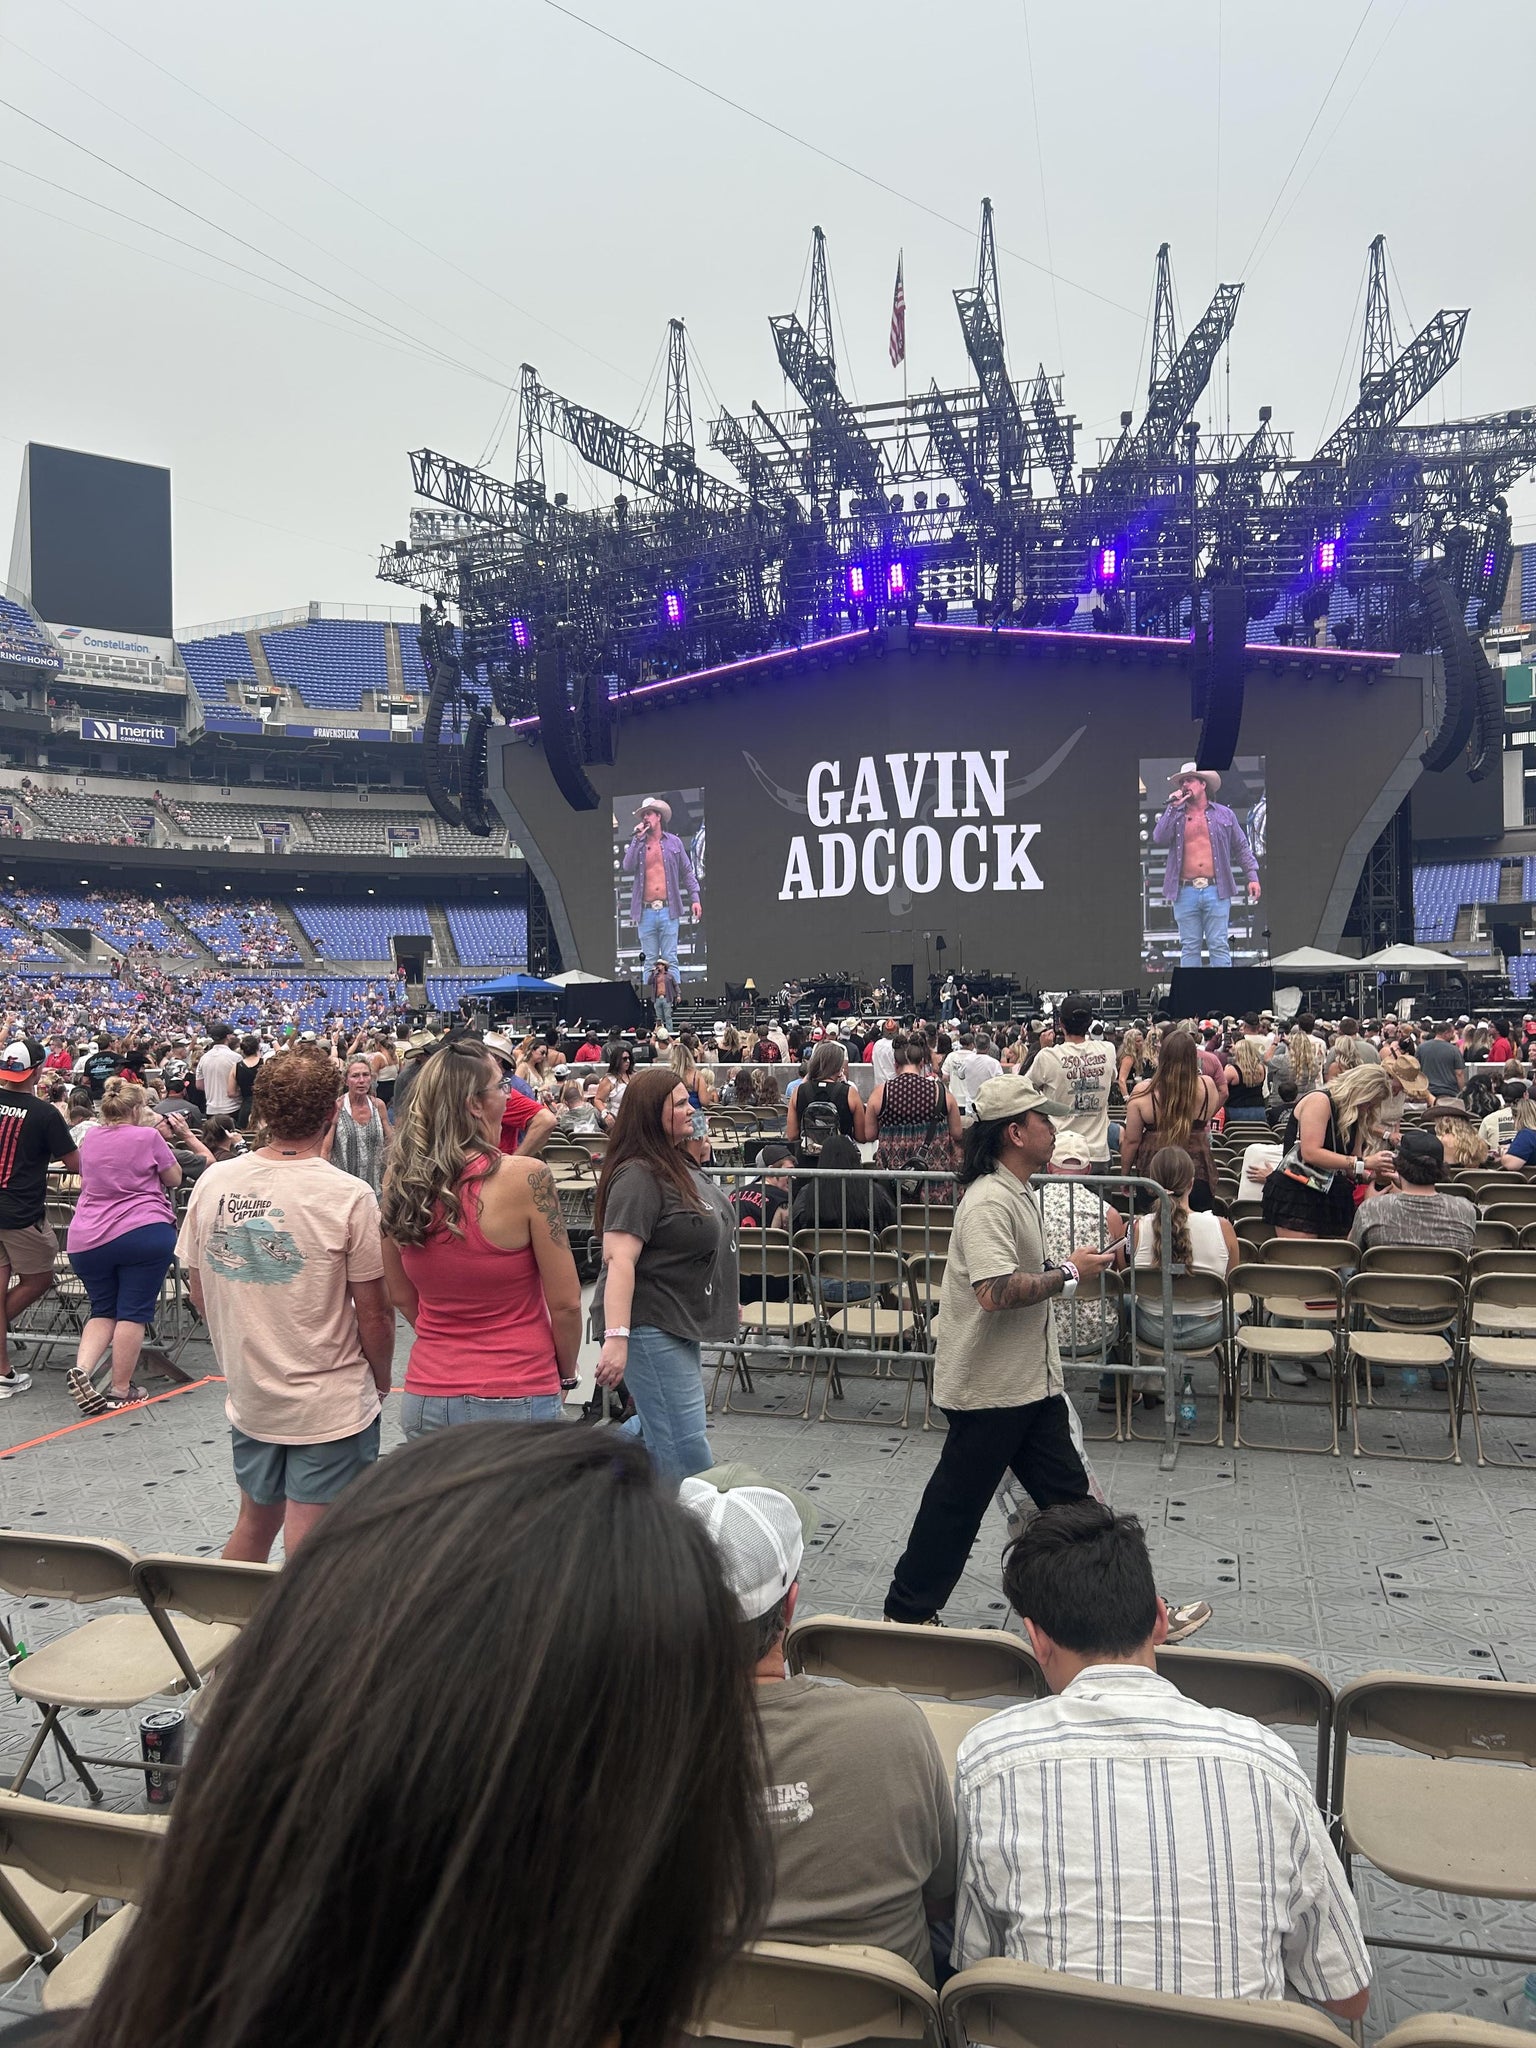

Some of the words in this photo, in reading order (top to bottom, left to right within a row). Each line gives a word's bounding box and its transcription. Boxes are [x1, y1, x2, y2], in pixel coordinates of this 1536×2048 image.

[83, 636, 149, 653] Constellation
[0, 651, 21, 661] RING
[27, 656, 59, 667] HONOR
[120, 726, 165, 739] merritt
[313, 727, 360, 739] #RAVENSFLOCK
[807, 750, 1009, 827] GAVIN
[778, 824, 1044, 900] ADCOCK
[228, 1199, 272, 1213] QUALIFIED
[233, 1209, 266, 1223] CAPTAIN
